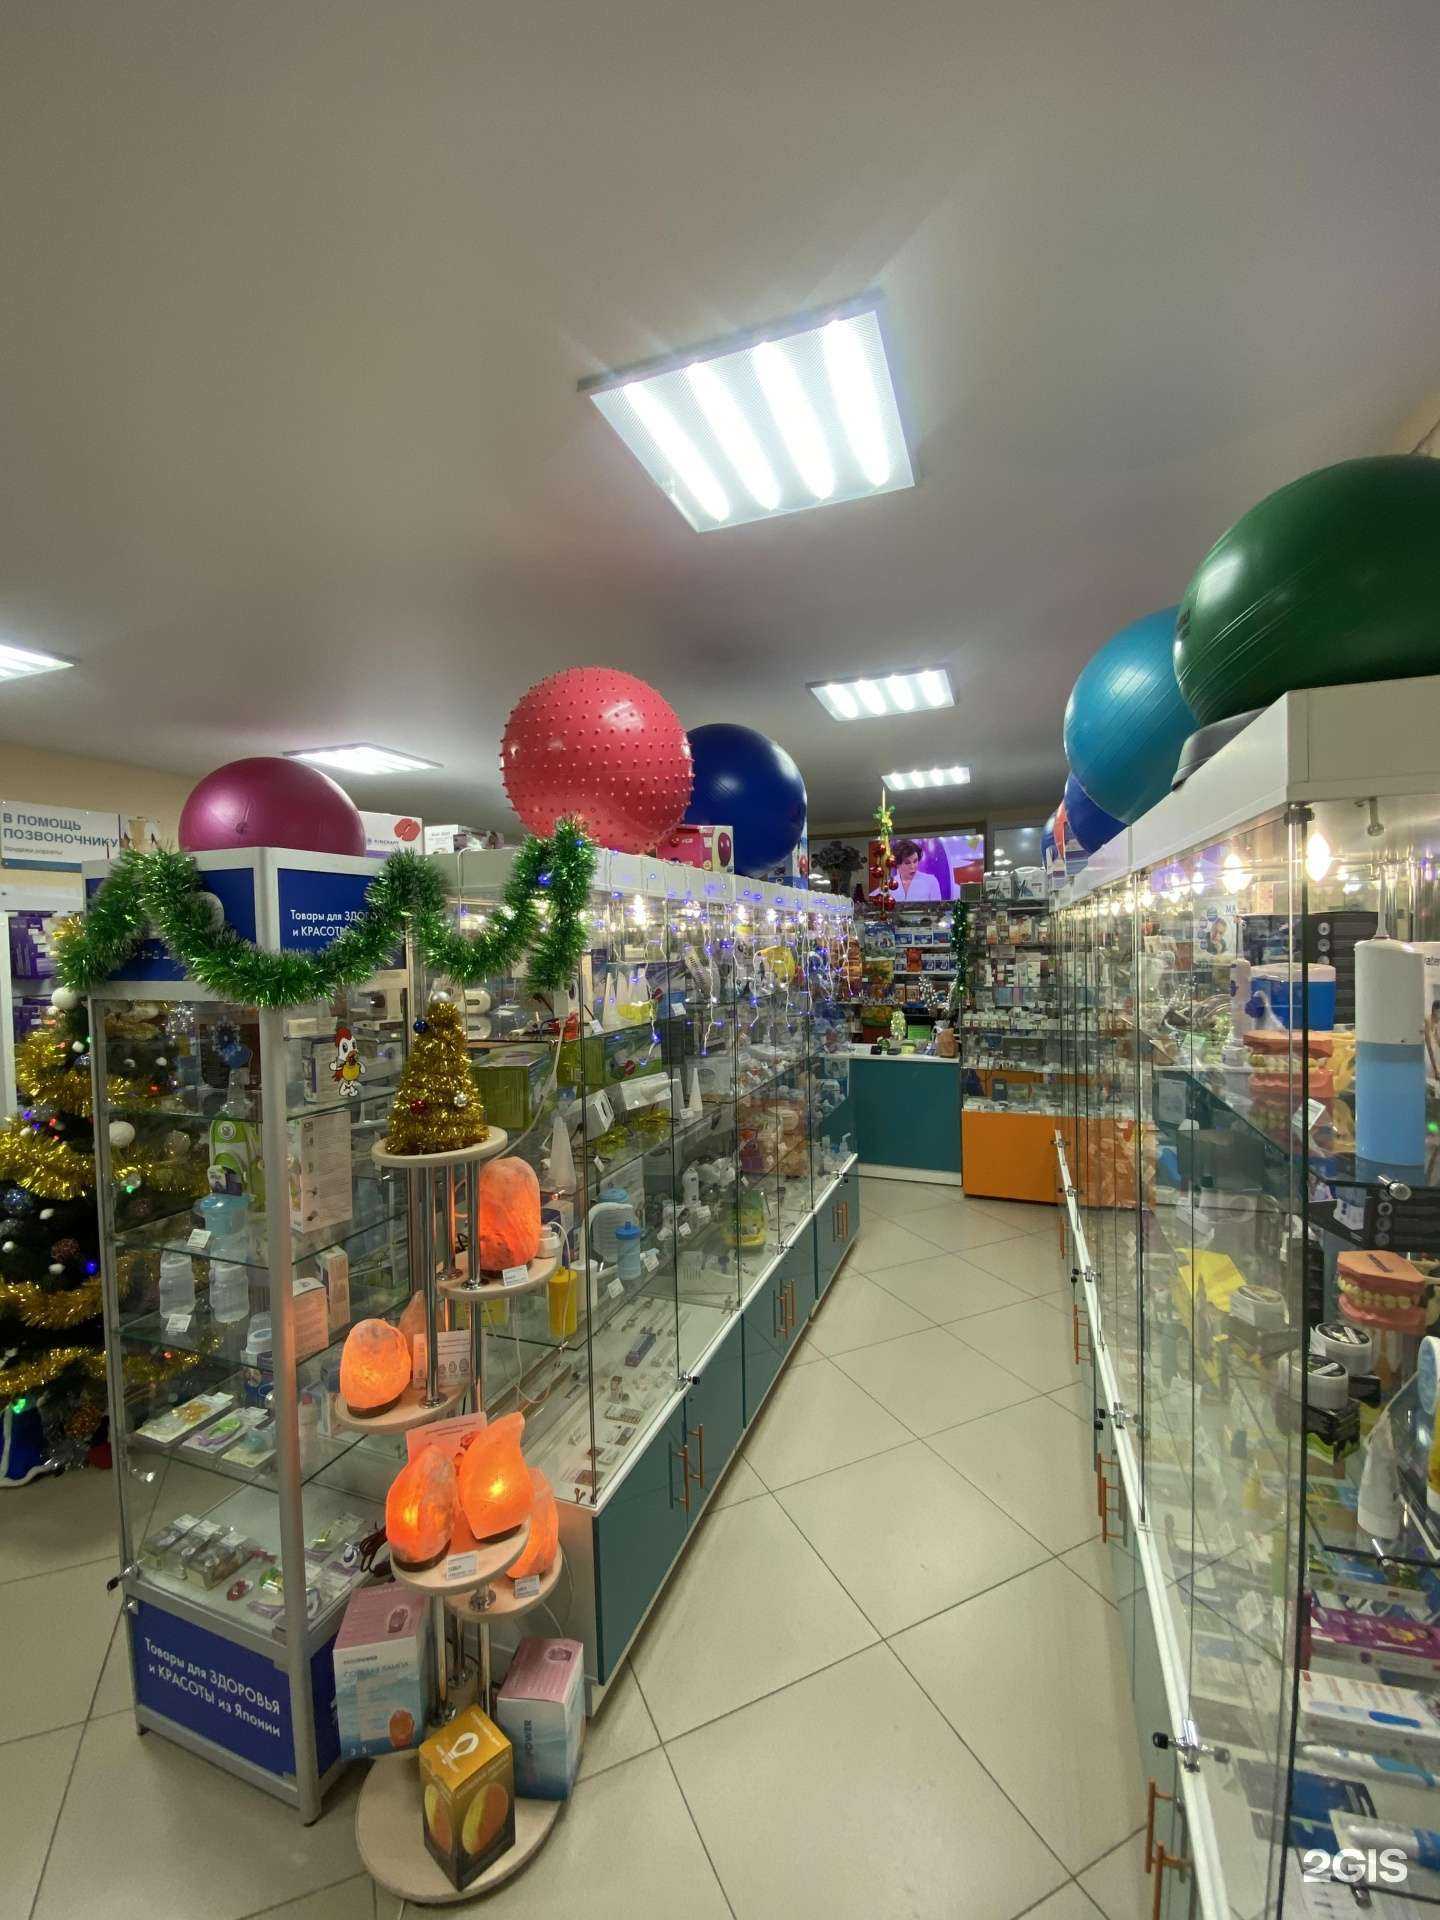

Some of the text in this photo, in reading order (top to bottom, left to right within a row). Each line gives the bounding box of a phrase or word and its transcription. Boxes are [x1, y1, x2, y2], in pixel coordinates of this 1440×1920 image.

[3, 812, 82, 831] В ПОМОЩЬ
[4, 828, 119, 848] ПОЗВОНОЧНИКУ
[290, 909, 325, 923] Товары
[327, 913, 342, 922] для
[293, 928, 299, 937] и
[144, 1637, 281, 1716] Товары для ЗДОРОВЬЯ
[149, 1664, 281, 1737] и КРАСОТЫ из Японии
